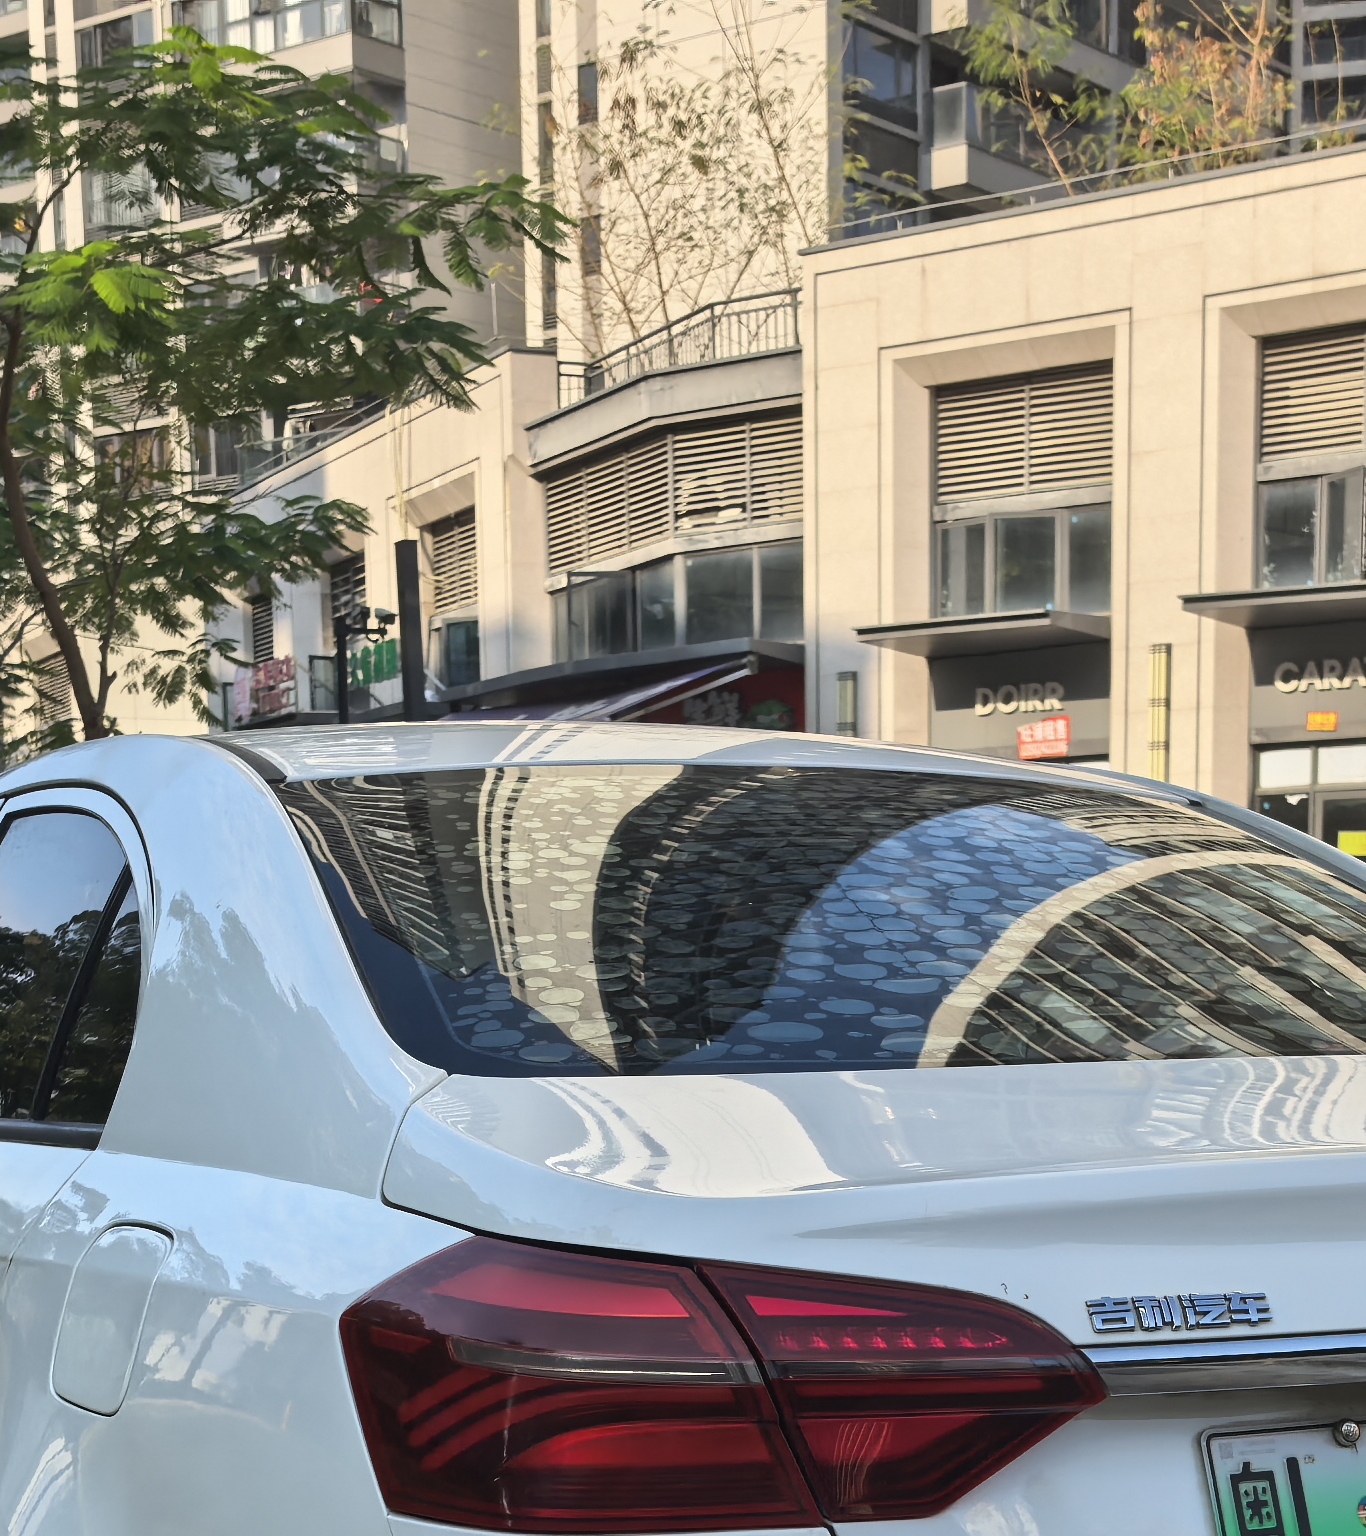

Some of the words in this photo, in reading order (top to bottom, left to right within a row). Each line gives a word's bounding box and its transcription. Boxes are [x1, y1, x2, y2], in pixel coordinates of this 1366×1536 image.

[975, 682, 1065, 716] DOIRR
[1086, 1291, 1274, 1333] 吉利汽车
